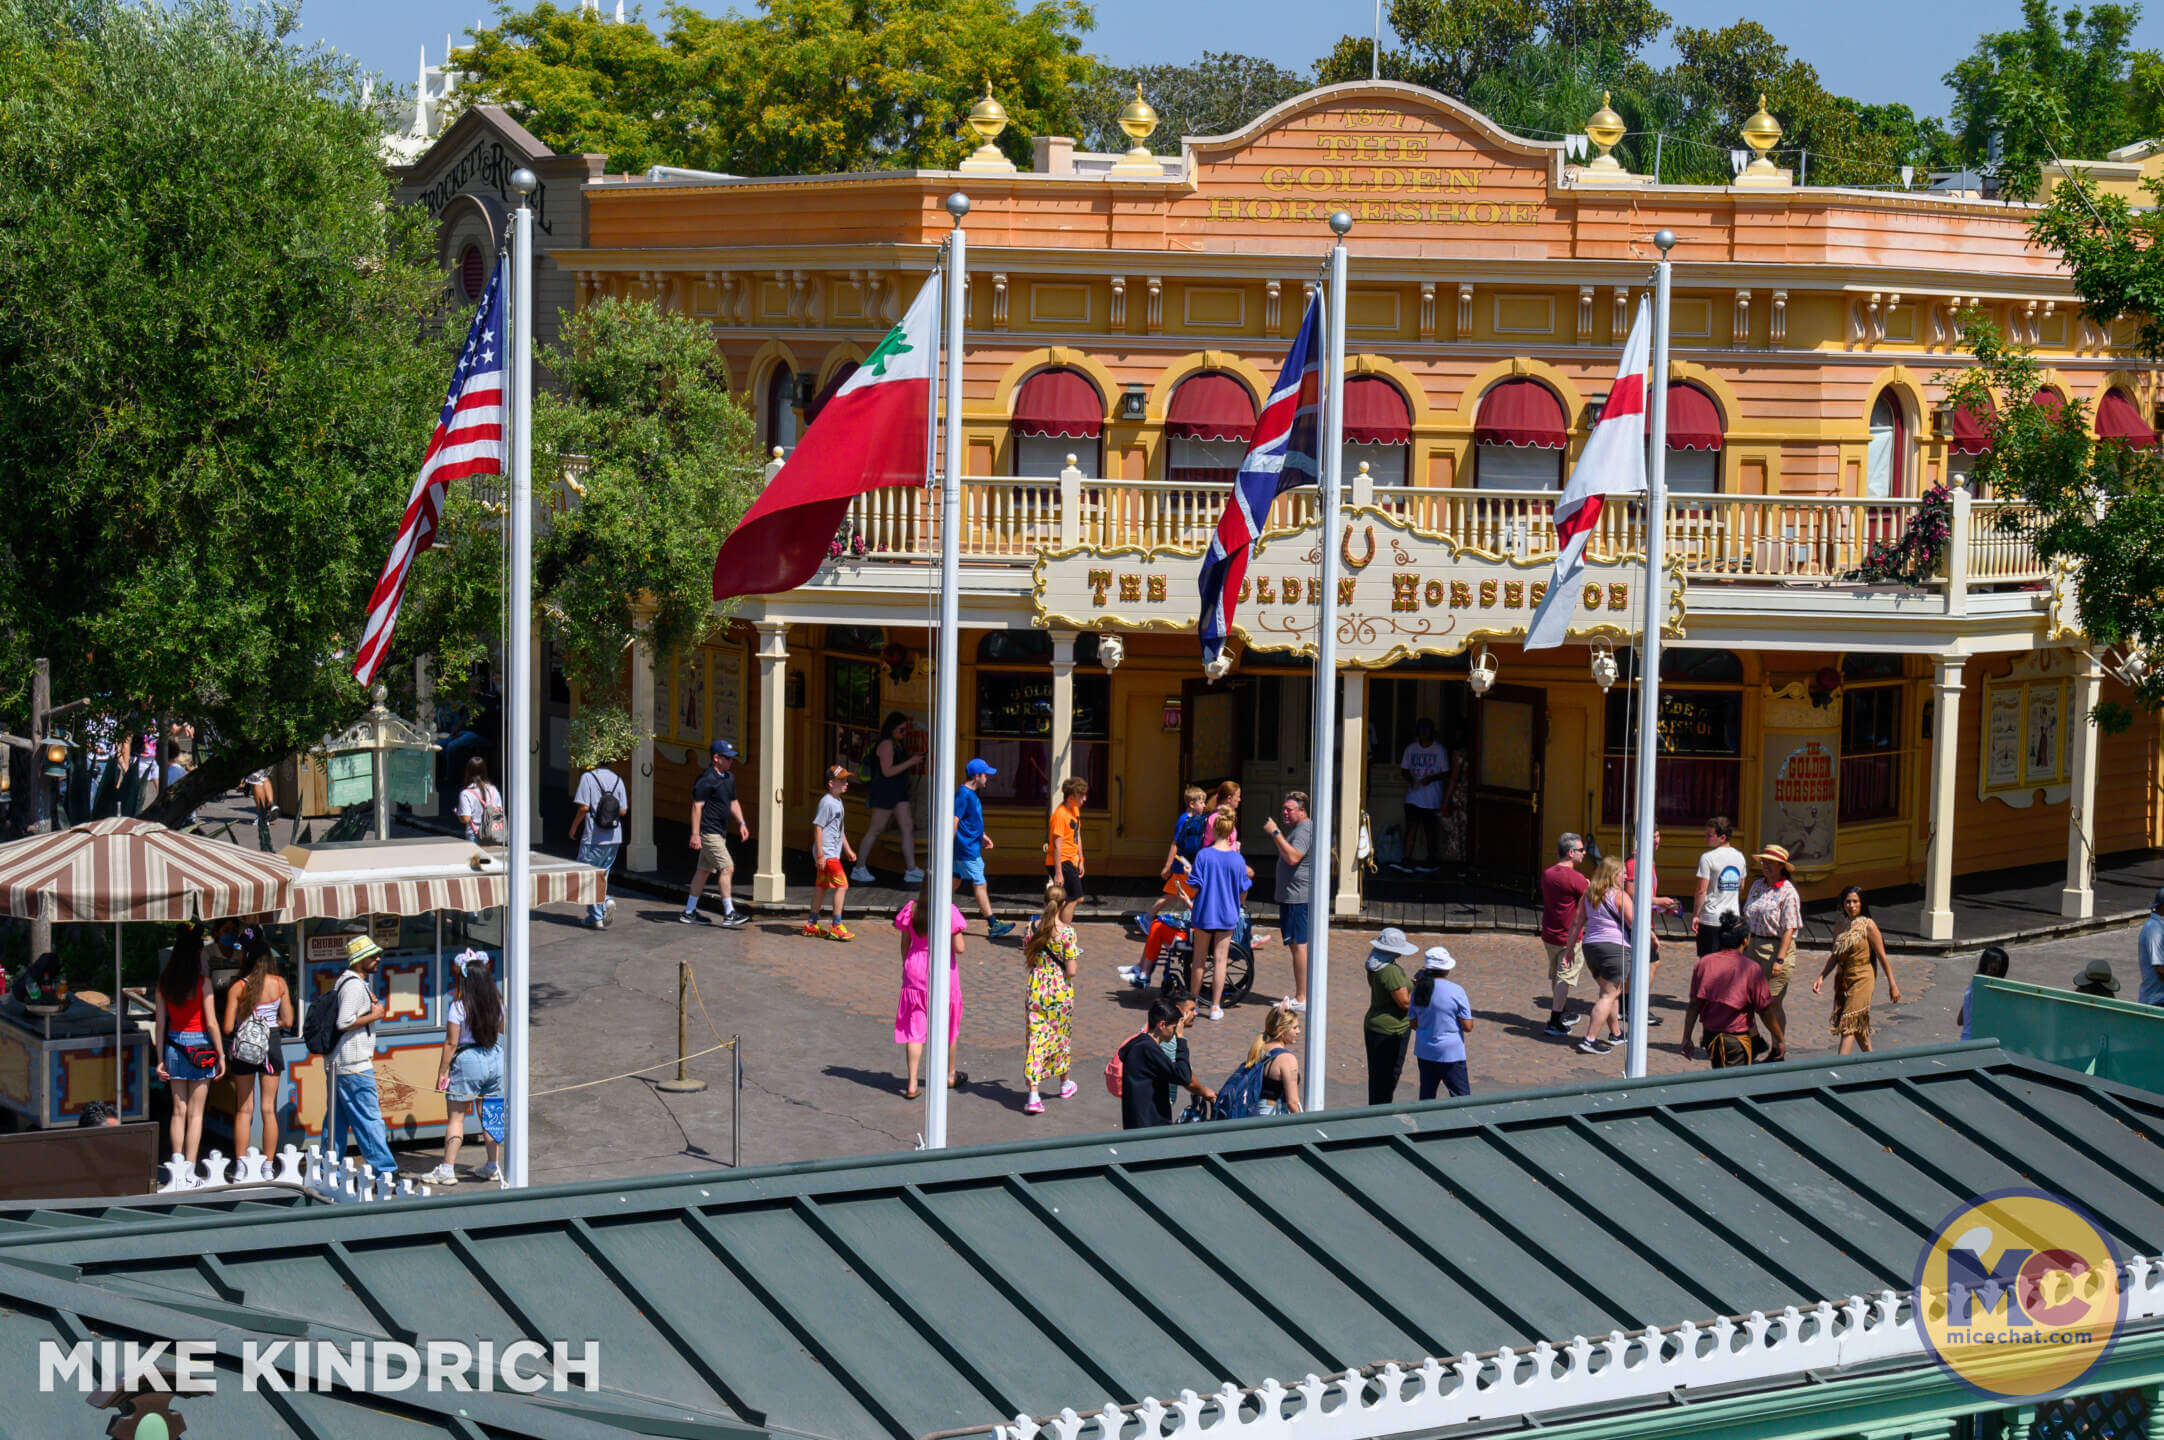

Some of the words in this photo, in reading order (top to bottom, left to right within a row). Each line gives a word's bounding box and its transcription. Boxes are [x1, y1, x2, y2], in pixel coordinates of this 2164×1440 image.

[1344, 108, 1403, 128] 1871
[1317, 135, 1429, 162] THE
[490, 142, 553, 236] RUEL
[1261, 166, 1483, 194] GOLDEN
[1205, 197, 1539, 226] HORSESHOE
[1088, 568, 1167, 605] THE
[1237, 575, 1357, 605] OLDEN
[1391, 572, 1628, 611] HORSESOE
[1788, 755, 1832, 779] GOLDEN
